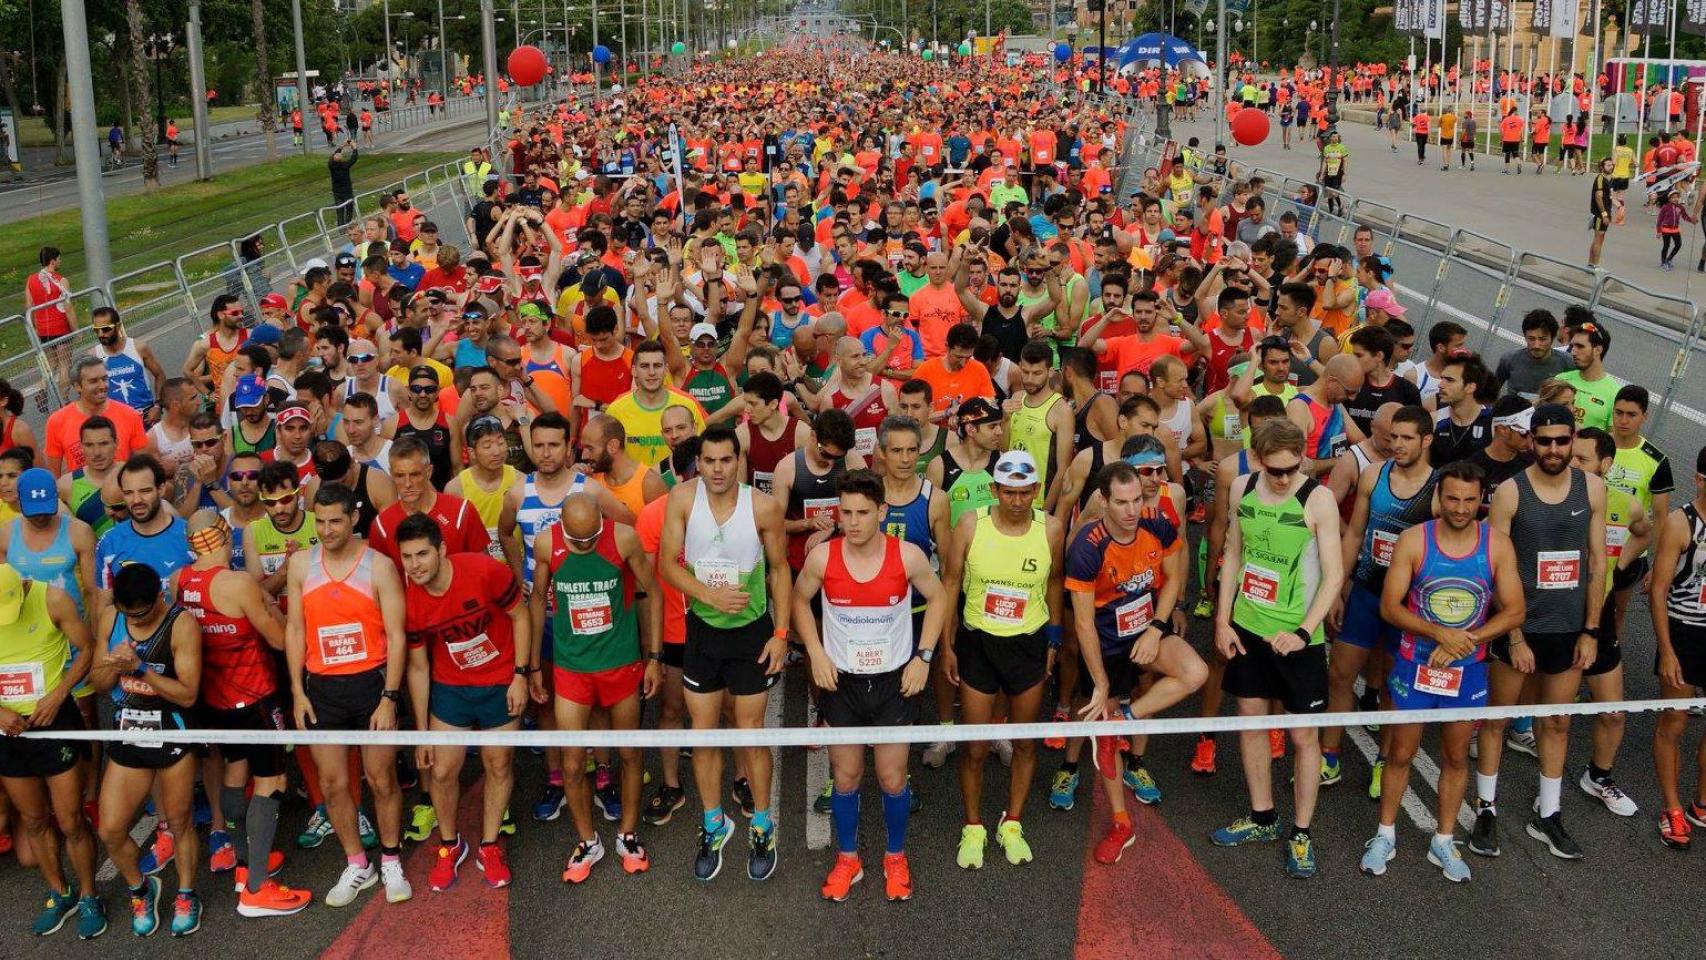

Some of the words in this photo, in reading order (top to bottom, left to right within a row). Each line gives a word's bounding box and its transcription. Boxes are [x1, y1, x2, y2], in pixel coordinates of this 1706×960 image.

[1021, 557, 1037, 572] LS
[1549, 571, 1572, 581] 4707
[556, 581, 591, 593] ATHLETIC
[592, 578, 619, 592] TRACK
[995, 599, 1018, 609] LUCIO
[838, 613, 895, 625] mediolanum
[335, 645, 354, 656] 464
[856, 650, 883, 658] ALBERT
[858, 657, 882, 667] 5220
[1427, 668, 1454, 681] OSCAR
[1429, 677, 1449, 688] 990
